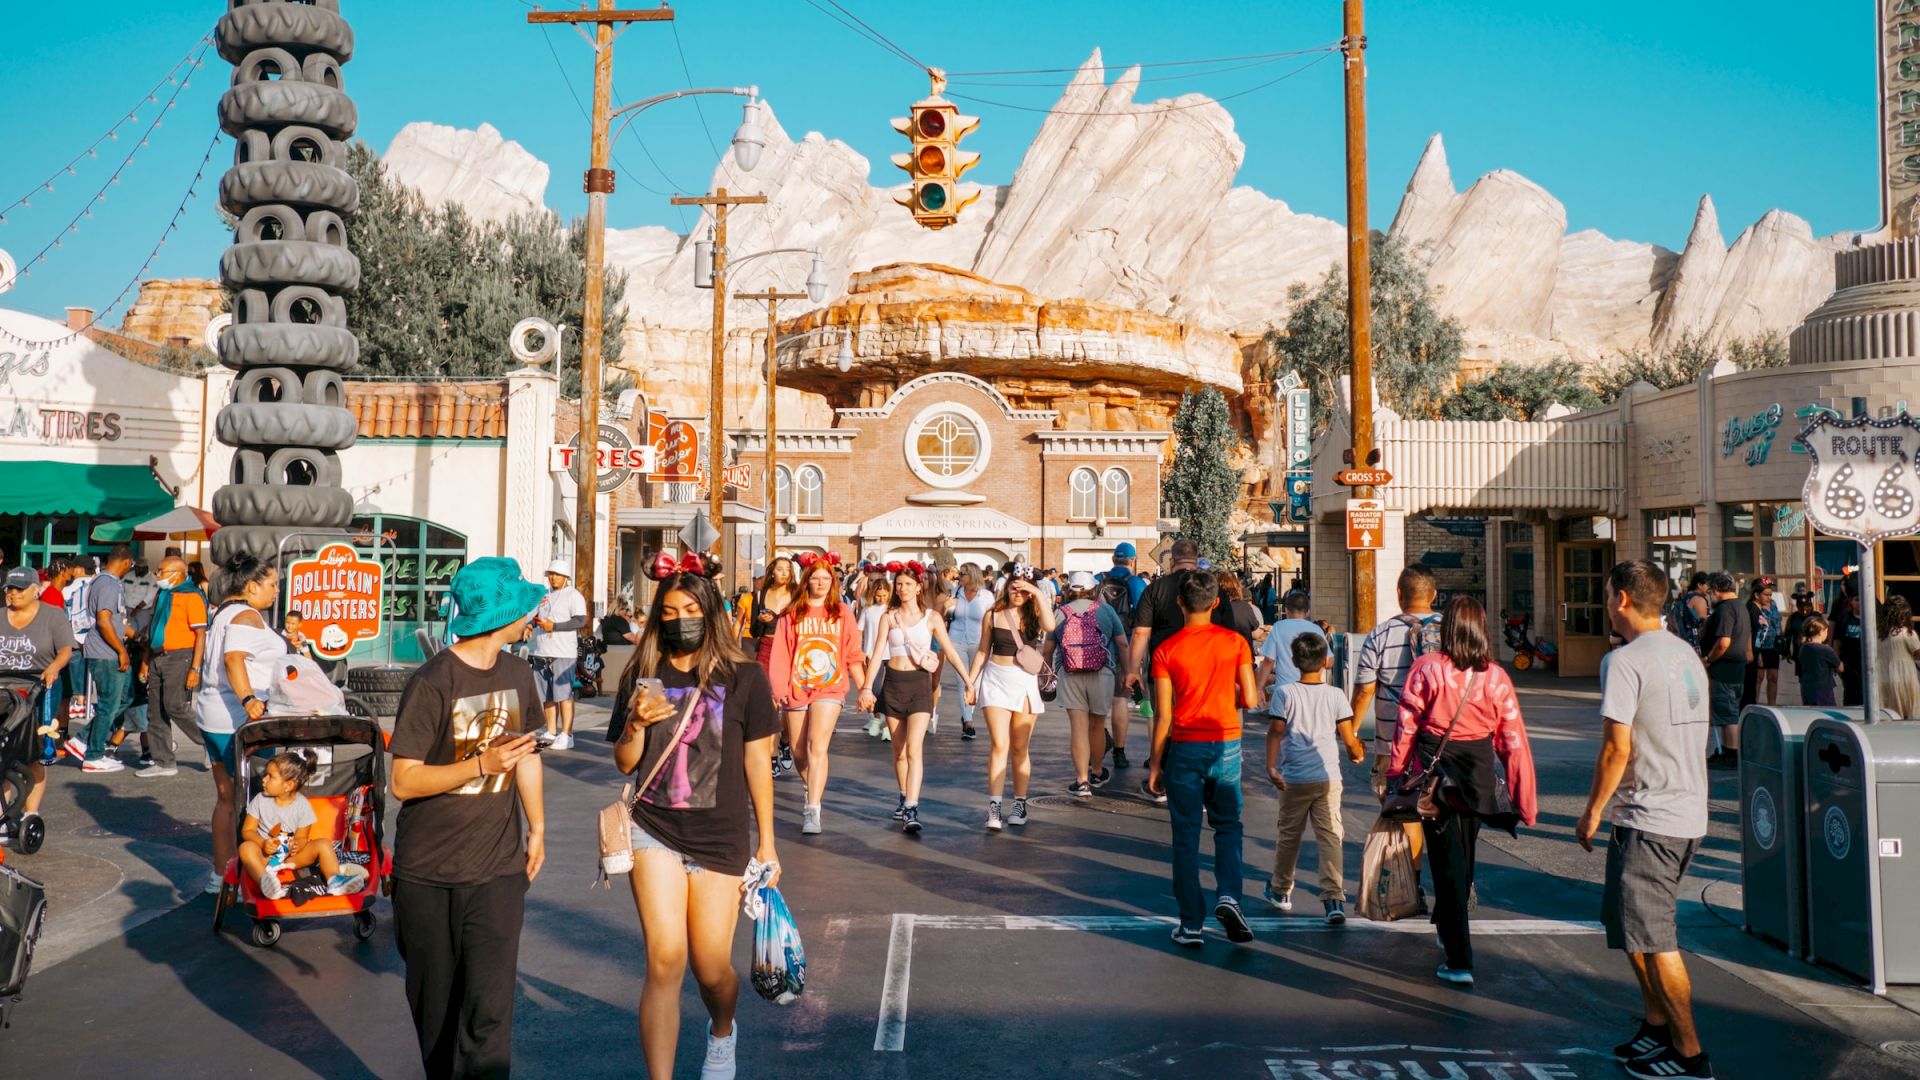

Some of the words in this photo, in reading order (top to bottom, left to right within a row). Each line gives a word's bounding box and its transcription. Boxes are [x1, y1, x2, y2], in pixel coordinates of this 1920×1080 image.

[39, 407, 122, 441] TIRES
[1723, 402, 1783, 460] House
[655, 433, 688, 454] Curb
[1831, 435, 1903, 456] ROUTE
[559, 448, 645, 468] TRES
[655, 447, 692, 472] Feeler
[722, 465, 750, 487] PLUGS
[1346, 472, 1373, 482] CROSS
[1825, 462, 1914, 519] 66
[886, 520, 949, 530] RADIATOR
[955, 520, 1009, 530] SPRINGS
[293, 569, 379, 597] ROLLICKIN'
